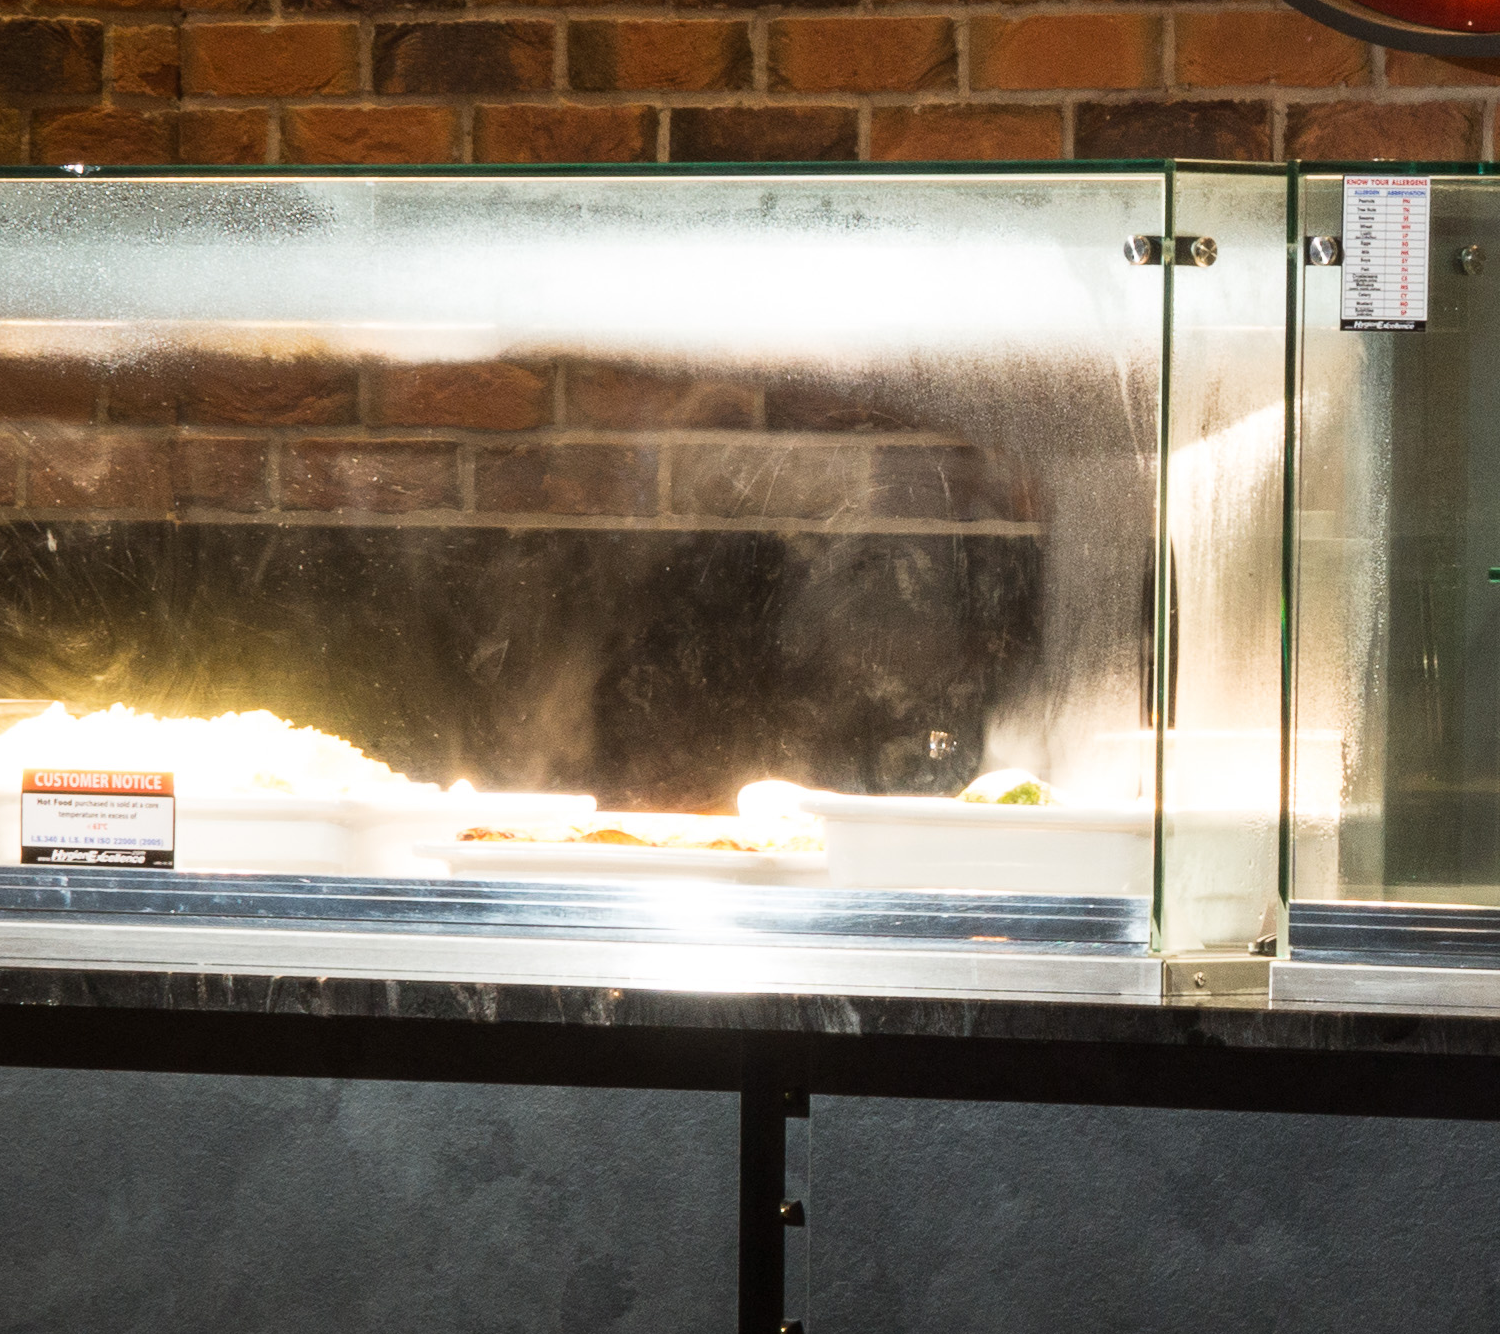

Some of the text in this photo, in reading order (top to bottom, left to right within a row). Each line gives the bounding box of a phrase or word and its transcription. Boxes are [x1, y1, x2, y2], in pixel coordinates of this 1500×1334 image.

[34, 772, 163, 790] CUSTOMER NOTICE
[53, 798, 73, 806] Food
